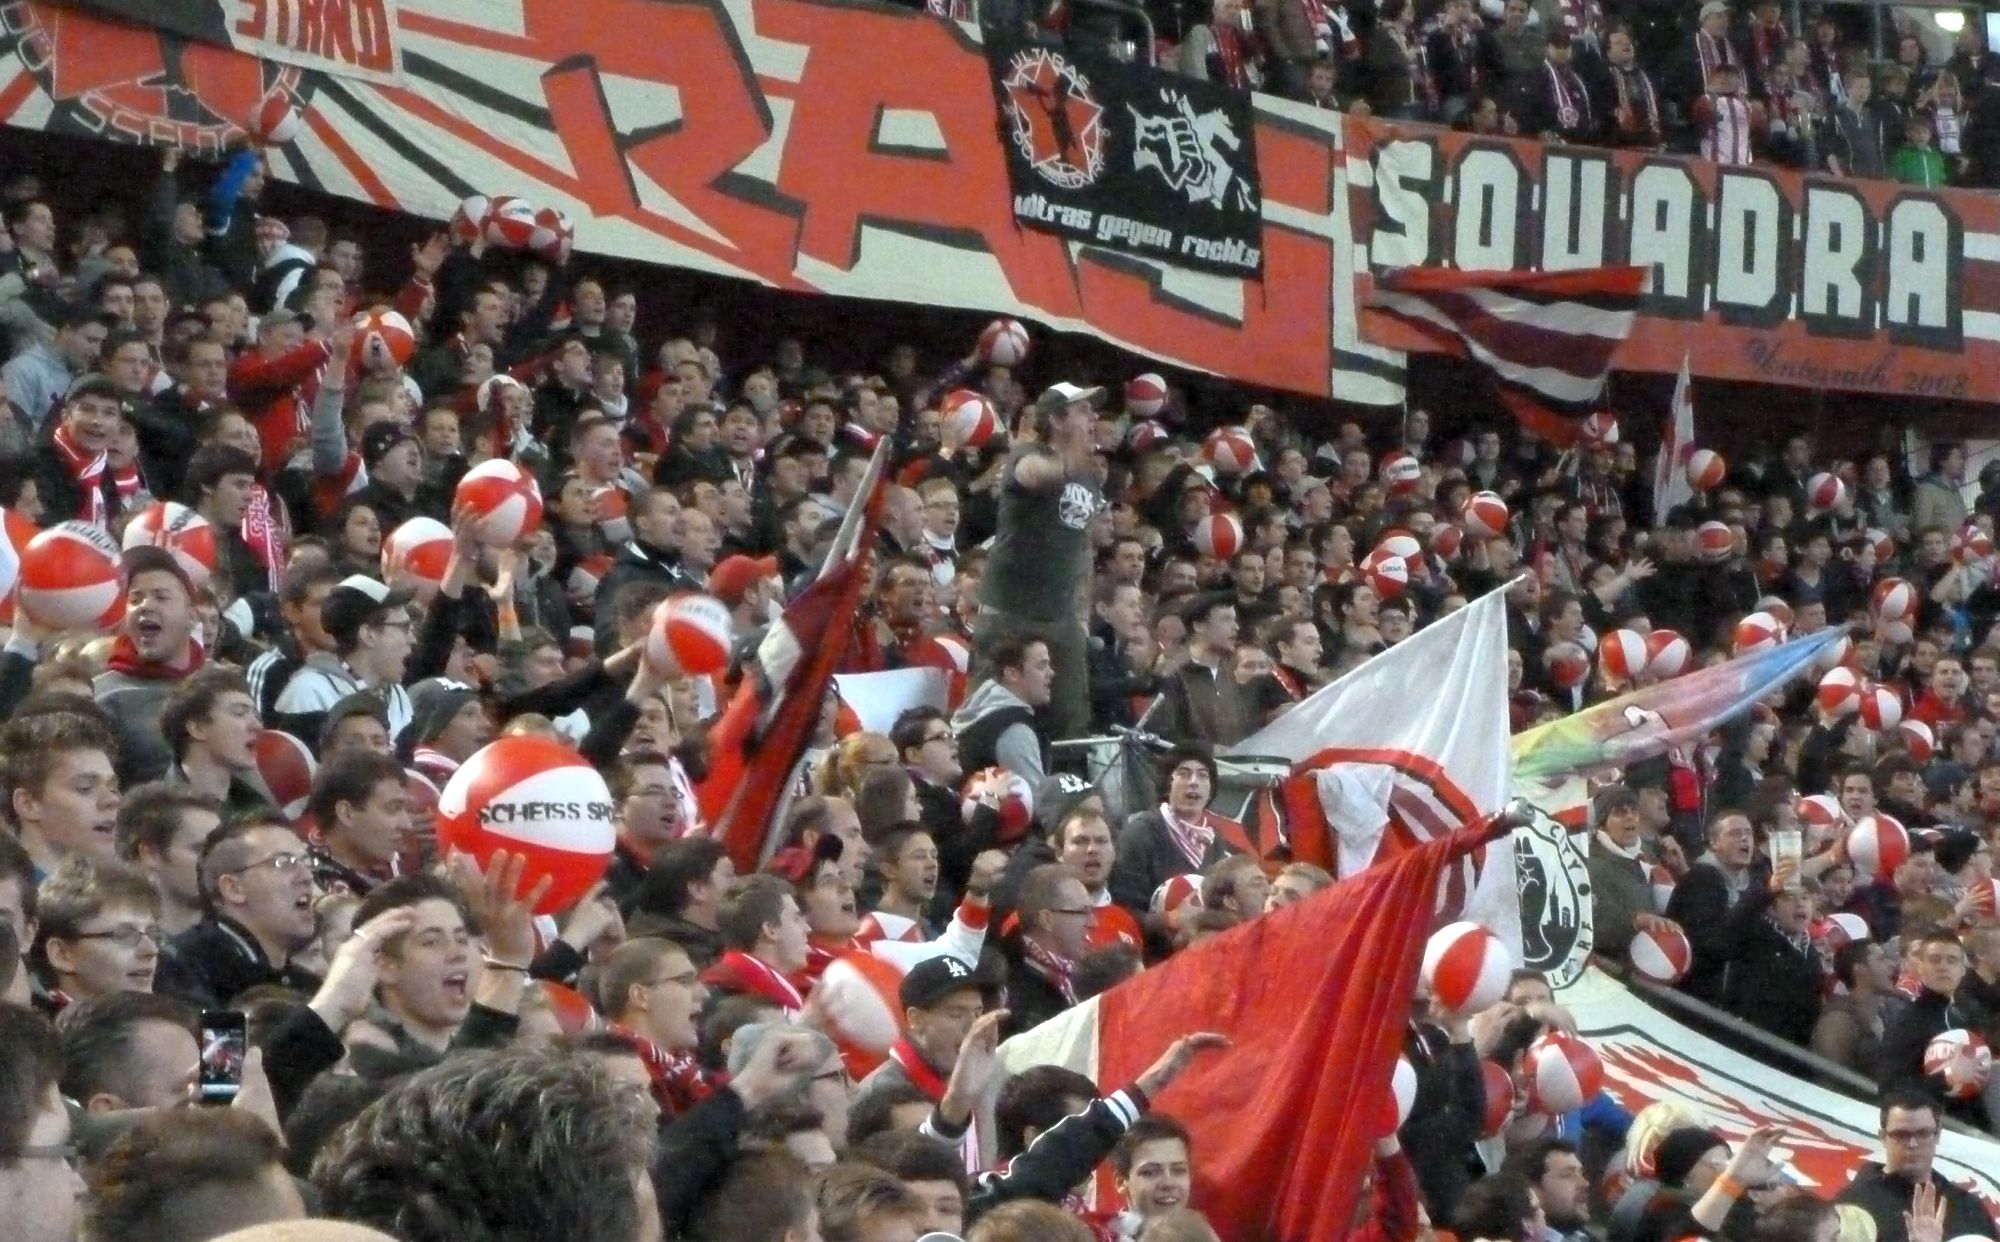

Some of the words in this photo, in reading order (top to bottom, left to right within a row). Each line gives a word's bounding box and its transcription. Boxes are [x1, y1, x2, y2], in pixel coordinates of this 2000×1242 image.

[1014, 193, 1092, 230] ultras
[1097, 214, 1173, 248] gegen
[1181, 234, 1261, 269] rechts
[478, 800, 581, 825] SCHEISS
